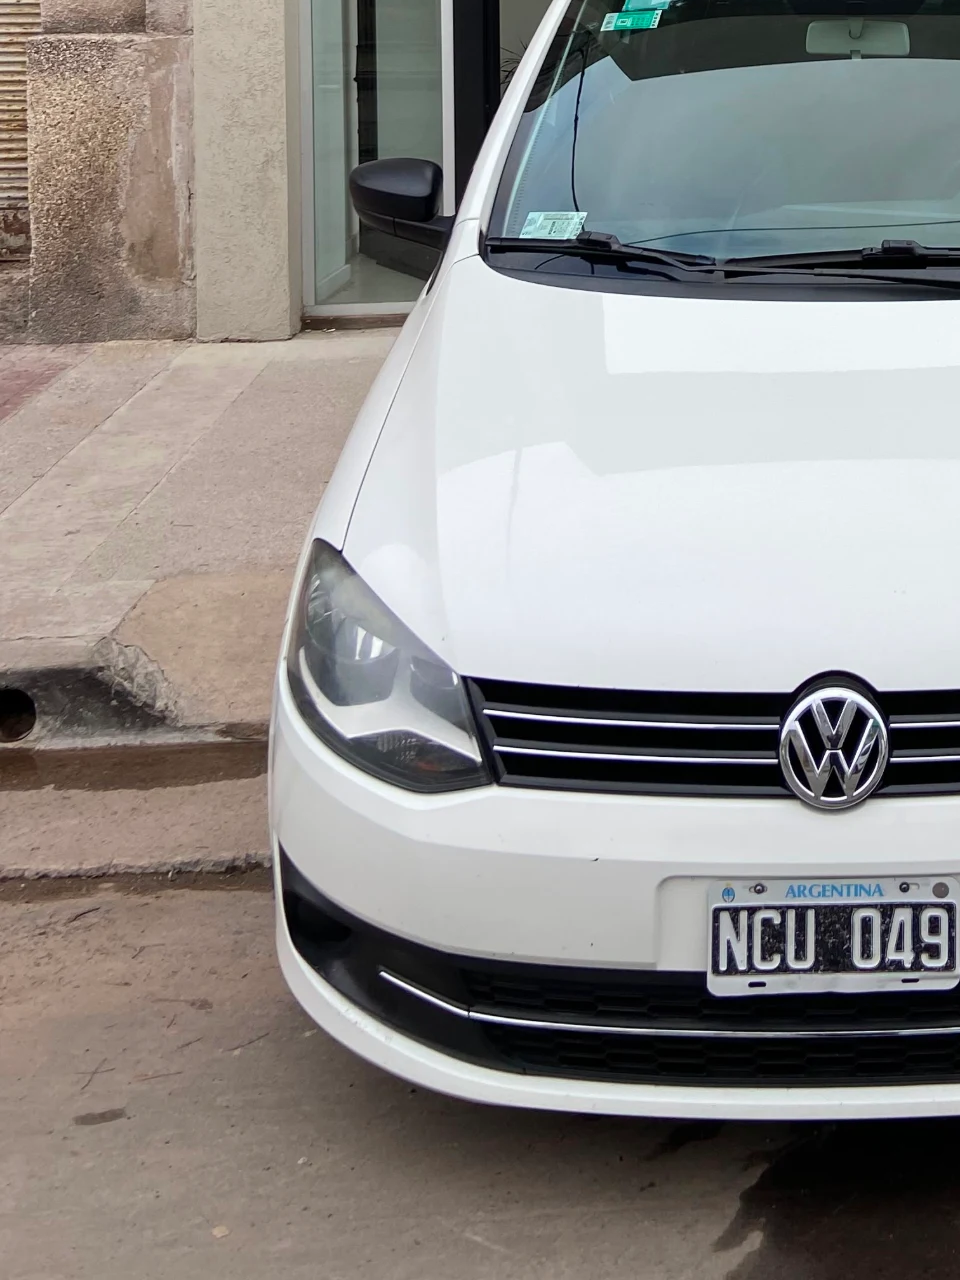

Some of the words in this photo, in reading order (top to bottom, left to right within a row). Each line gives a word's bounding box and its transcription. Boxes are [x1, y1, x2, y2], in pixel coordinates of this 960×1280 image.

[785, 883, 884, 898] ARGENTINA
[719, 908, 816, 971] NCU
[851, 907, 949, 970] 049
